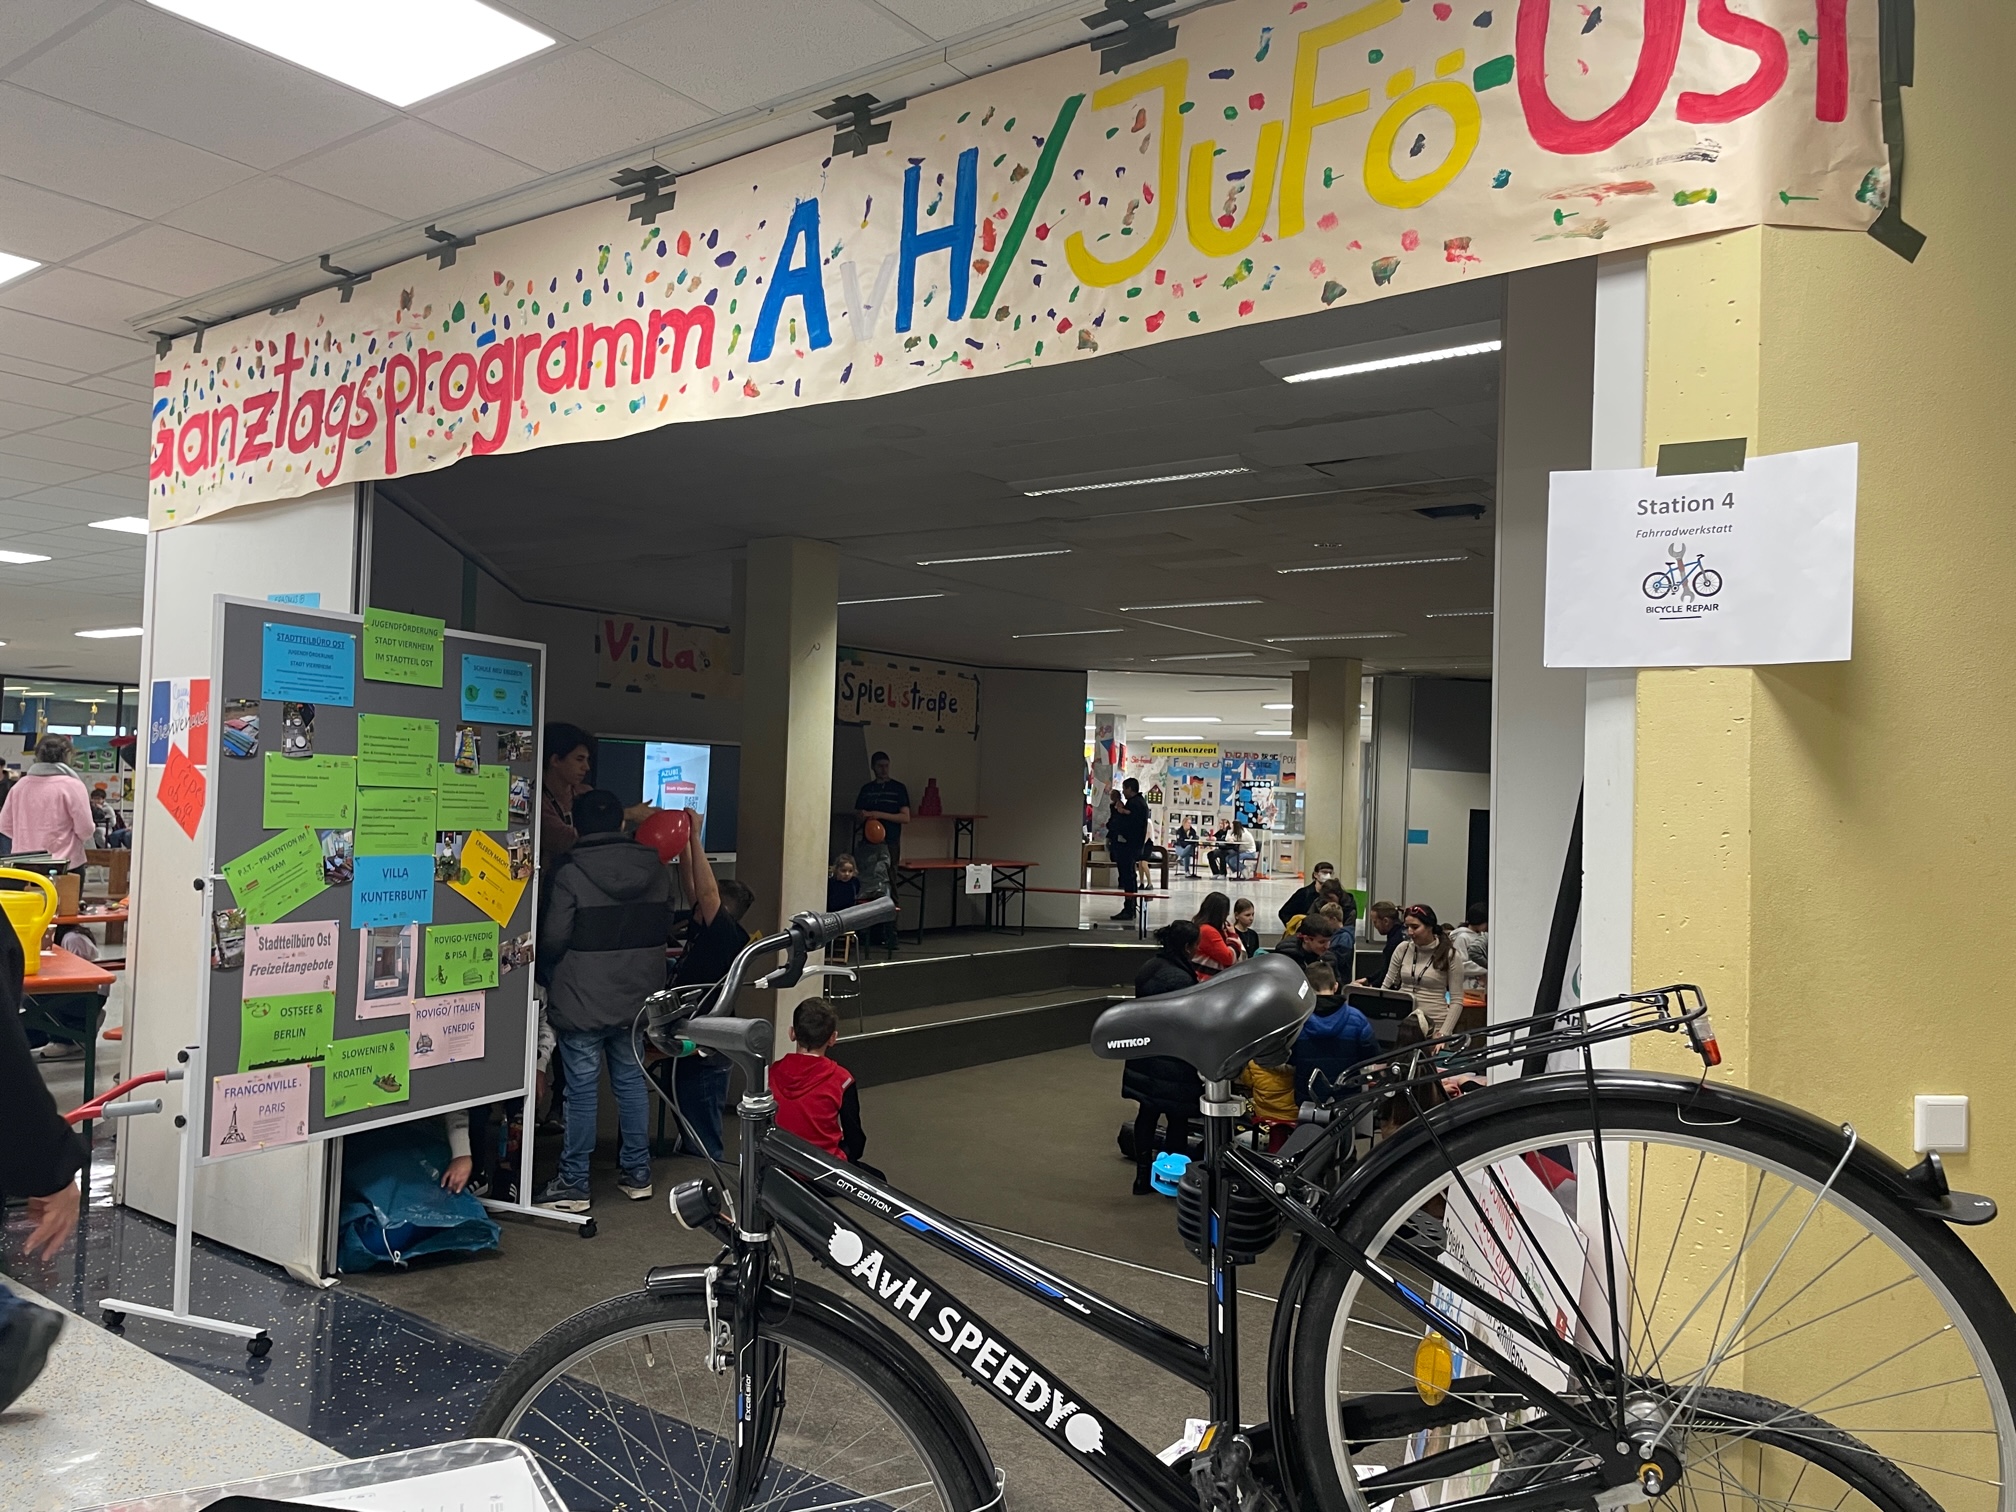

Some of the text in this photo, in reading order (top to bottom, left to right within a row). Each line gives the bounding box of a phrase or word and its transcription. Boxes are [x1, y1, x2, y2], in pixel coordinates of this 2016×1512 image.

[1636, 492, 1735, 516] Station 4
[1635, 524, 1733, 539] Fahrradwerkstatt
[1645, 602, 1720, 614] BICYCLE REPAIR
[371, 619, 438, 637] JUGENDFÖRDERUNG
[276, 632, 345, 650] STADTTEILBÜRO OST
[374, 636, 434, 652] STADT VIERNHEIM
[375, 653, 434, 668] IM STADTTEIL OST
[151, 702, 210, 744] Bienvenue!
[1151, 746, 1218, 755] Fahrtenkonzept
[237, 864, 255, 876] P.I.T.
[259, 837, 297, 865] PRÄVENTION
[297, 832, 307, 842] IM
[267, 859, 286, 874] TEAM
[382, 867, 409, 879] VILLA
[360, 889, 428, 903] KUNTERBUNT
[258, 932, 331, 952] Stadtteilbüro Ost
[434, 931, 493, 944] ROVIGO-VENEDIG
[444, 950, 468, 960] & PISA
[249, 958, 334, 977] Freizeitangebote
[280, 1003, 323, 1017] OSTSEE &
[416, 1002, 481, 1020] ROVIGO/ ITALIEN
[273, 1027, 306, 1040] BERLIN
[442, 1022, 475, 1036] VENEDIG
[1106, 1036, 1151, 1049] WITTKOP
[341, 1042, 396, 1060] SLOWENIEN &
[333, 1065, 373, 1081] KROATIEN
[258, 1102, 286, 1116] PARIS
[836, 1178, 892, 1213] CITY EDITION
[850, 1249, 1081, 1431] AvH SPEEDY
[744, 1373, 752, 1421] Excelsior
